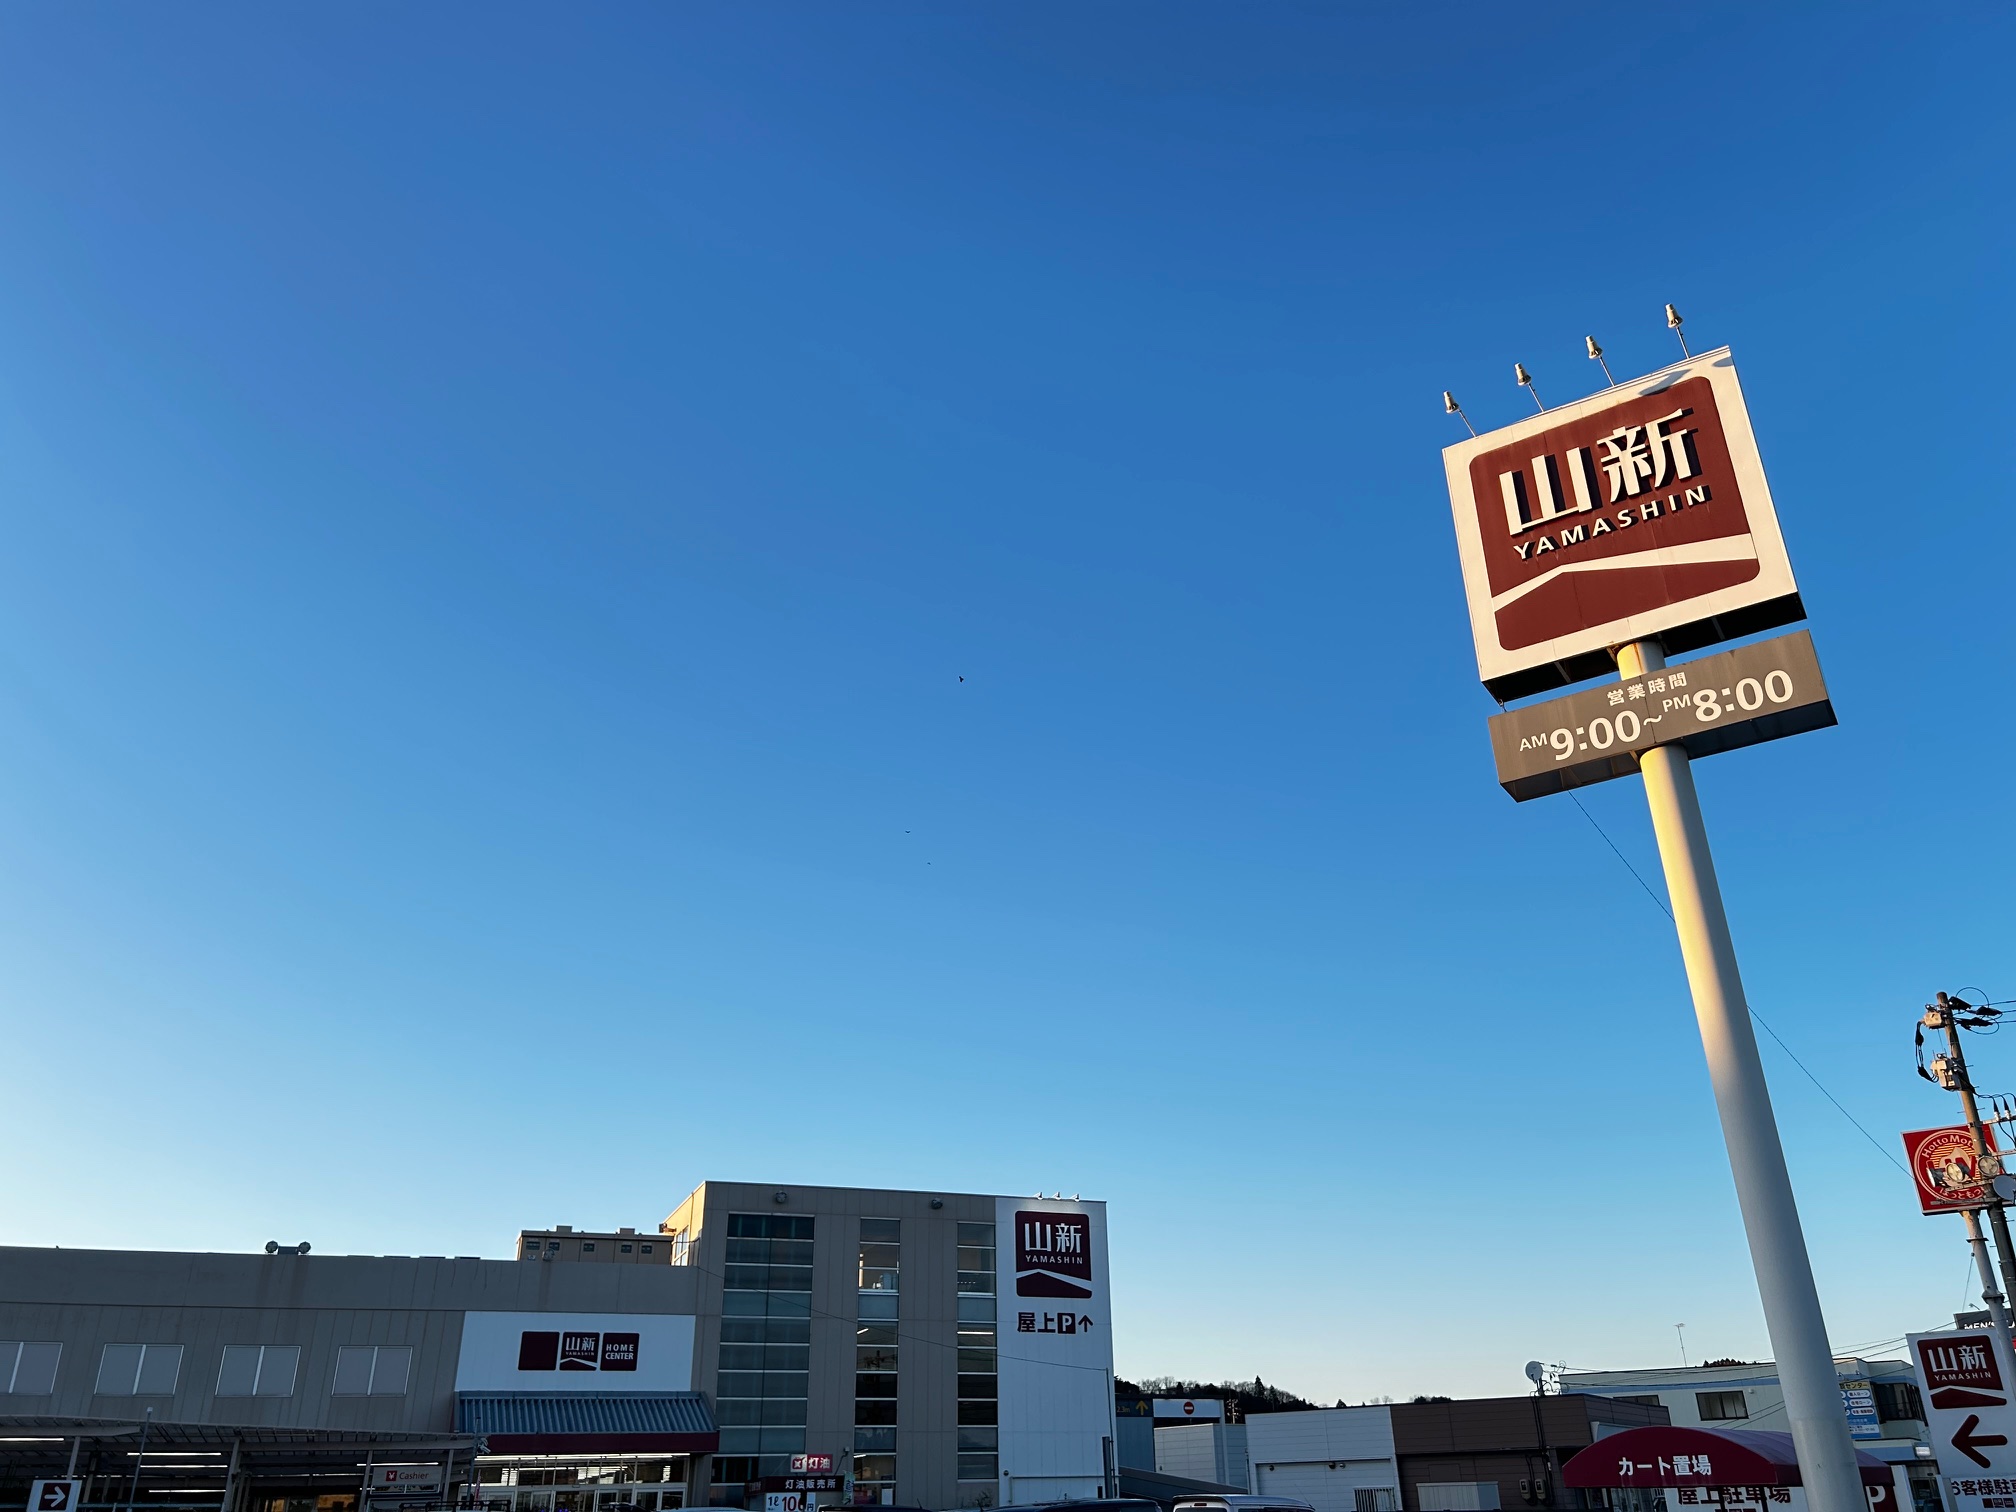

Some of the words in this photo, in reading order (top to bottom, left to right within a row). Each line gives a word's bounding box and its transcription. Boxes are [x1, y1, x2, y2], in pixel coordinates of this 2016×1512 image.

[1498, 407, 1693, 537] 山新
[1513, 484, 1707, 561] YAMASHIN
[1607, 672, 1687, 706] 営業時間
[1024, 1221, 1082, 1253] 山新
[1025, 1254, 1083, 1265] YAMASHIN
[565, 1336, 596, 1351] 山新
[605, 1343, 634, 1352] HOME
[605, 1352, 634, 1360] CENTER
[1927, 1344, 1987, 1372] 山新
[1934, 1371, 1992, 1382] YAMASHIN
[808, 1457, 831, 1469] 灯油
[1618, 1454, 1712, 1477] カート置場
[398, 1471, 429, 1480] Cashier
[785, 1478, 836, 1490] 灯油販売所
